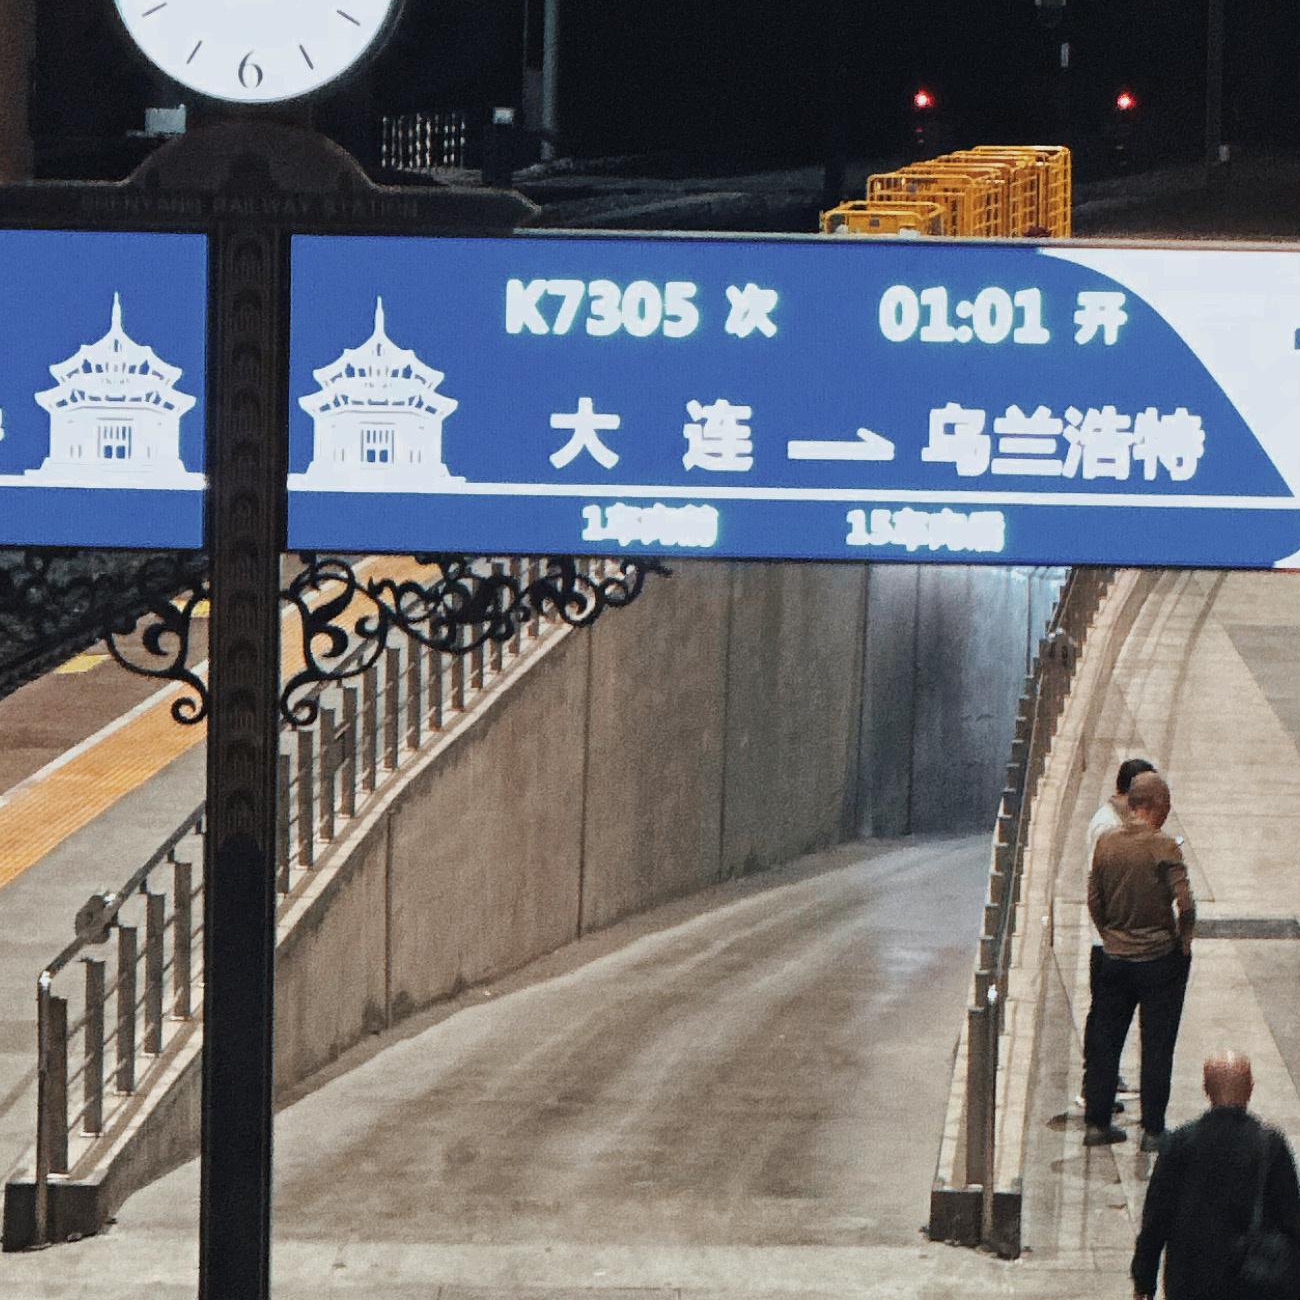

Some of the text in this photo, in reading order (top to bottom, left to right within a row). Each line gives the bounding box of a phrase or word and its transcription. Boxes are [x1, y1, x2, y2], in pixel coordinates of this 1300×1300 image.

[237, 50, 264, 89] 6
[505, 279, 778, 338] K7305 次
[879, 285, 1127, 345] 01:01 开
[921, 402, 1205, 480] 乌兰浩特
